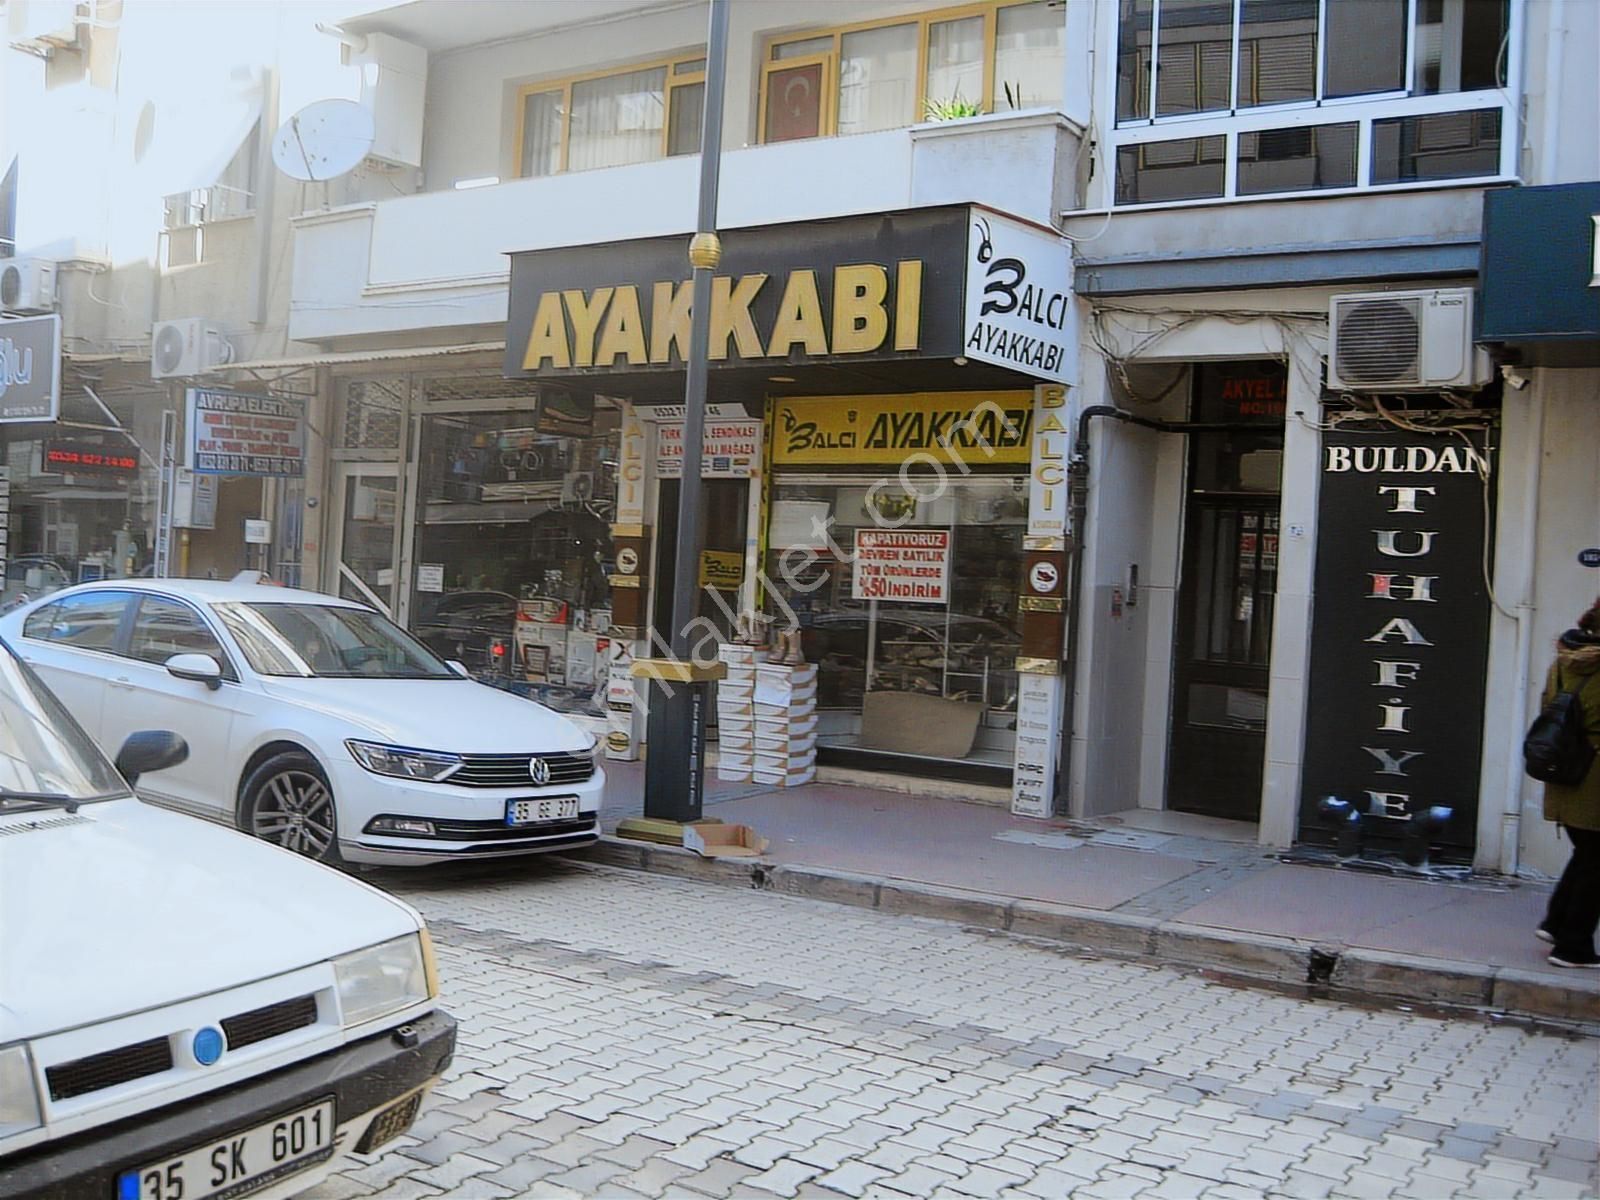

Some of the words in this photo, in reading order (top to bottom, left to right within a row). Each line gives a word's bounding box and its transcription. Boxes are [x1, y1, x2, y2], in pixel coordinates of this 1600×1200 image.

[521, 260, 924, 371] AYAKKABI
[980, 258, 1068, 330] BALCI
[967, 322, 1065, 374] AYAKKABI
[864, 408, 1033, 449] AYAKKABI
[1035, 387, 1068, 511] BALCI
[1325, 446, 1495, 474] BULDAN
[883, 564, 942, 578] ÜRÜNLERDE
[902, 550, 945, 562] SATILIK
[1362, 486, 1439, 822] TUHAFİYE
[515, 803, 529, 820] 35
[557, 799, 577, 817] 377
[143, 1161, 184, 1200] 35
[211, 1137, 247, 1188] SK
[272, 1109, 323, 1162] 601
